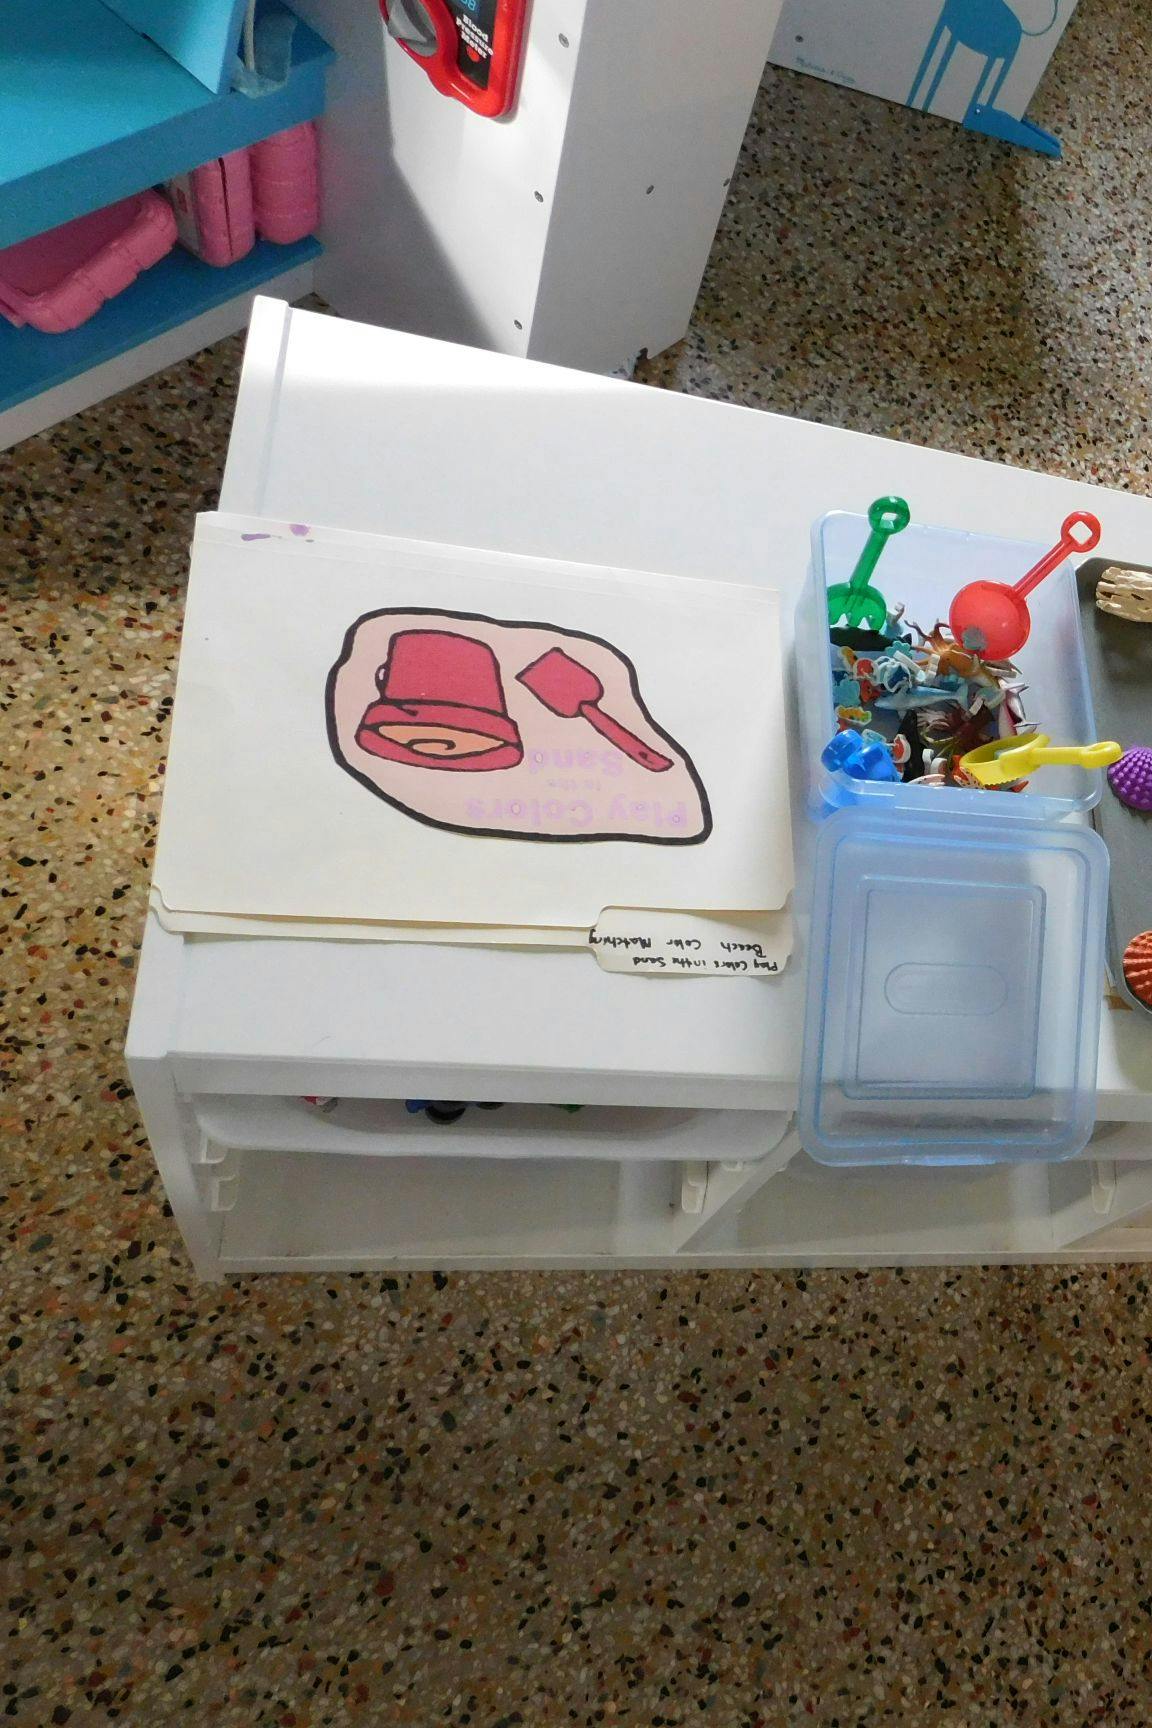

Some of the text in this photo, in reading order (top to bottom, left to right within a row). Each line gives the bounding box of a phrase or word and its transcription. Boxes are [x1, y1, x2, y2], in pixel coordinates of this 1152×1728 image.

[456, 16, 493, 55] Pressure
[463, 14, 488, 42] Blood
[461, 30, 487, 58] Meter
[529, 749, 624, 777] Sand
[465, 794, 688, 828] Play Colors
[589, 929, 767, 958] Beach Color Matching
[632, 956, 665, 968] Sand
[713, 959, 748, 971] Colors
[753, 959, 778, 972] Play
